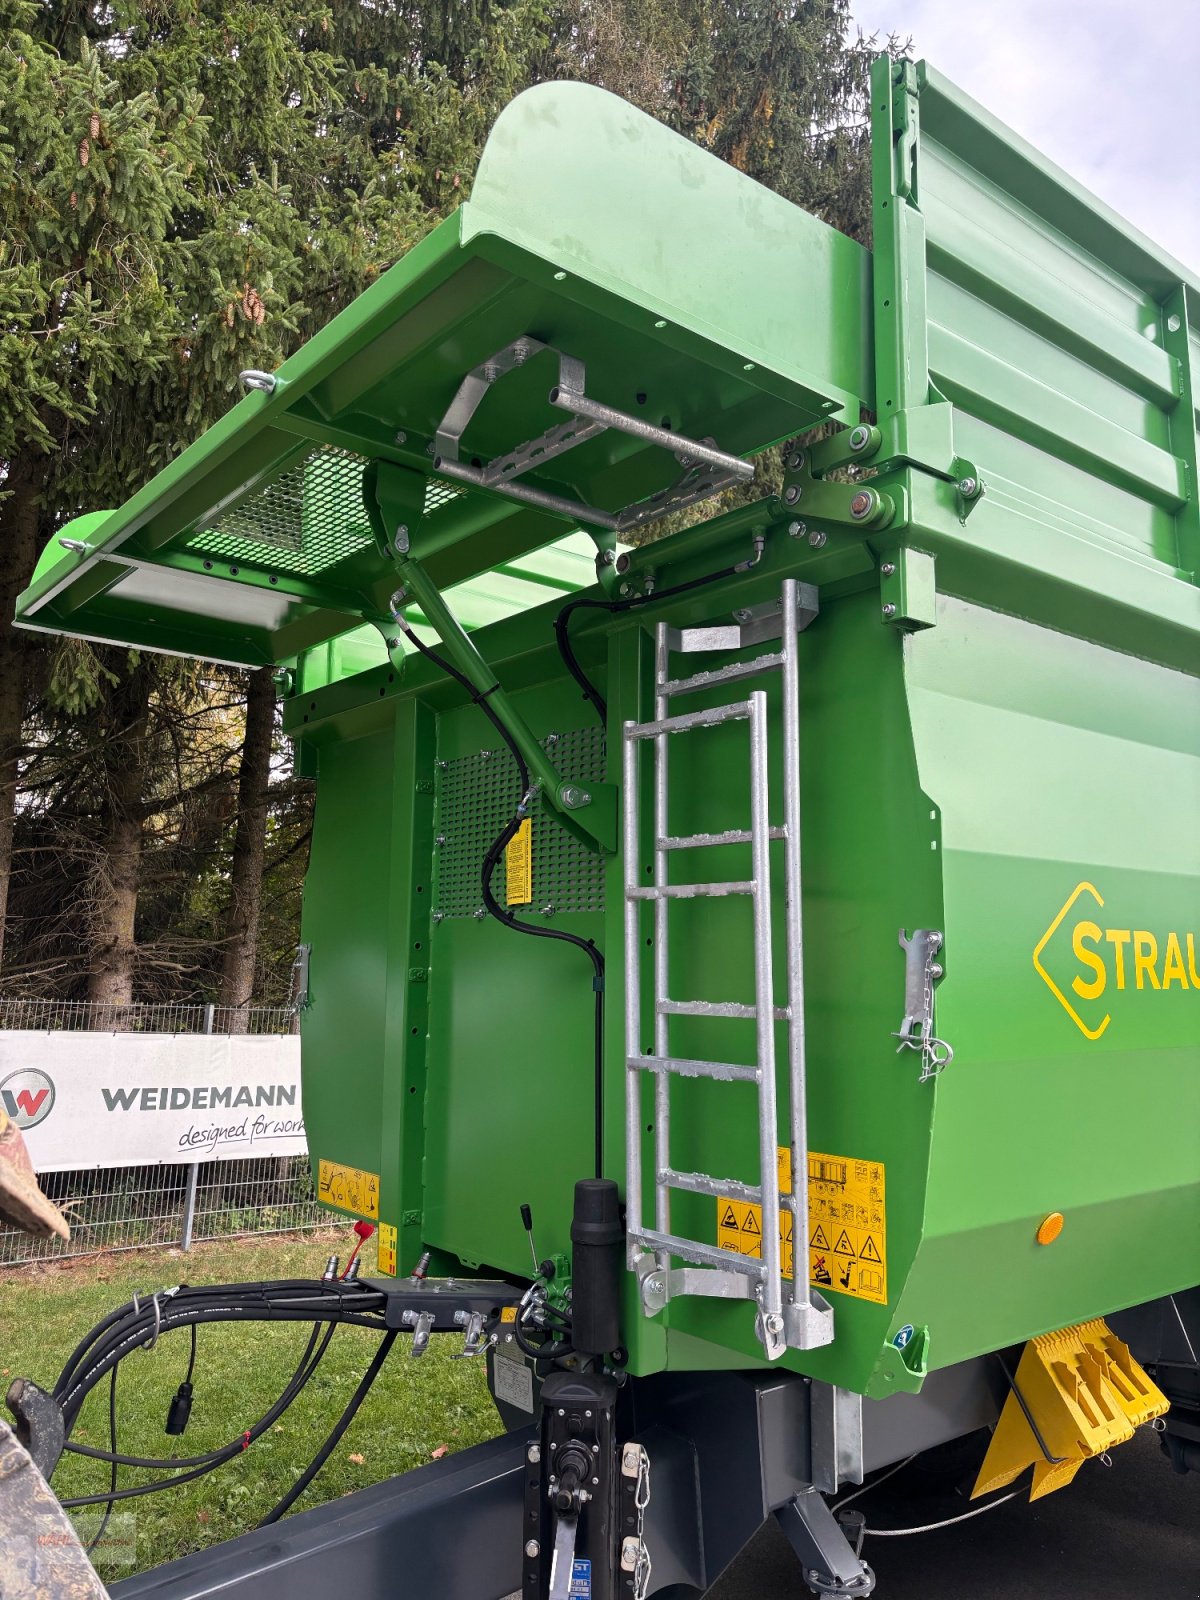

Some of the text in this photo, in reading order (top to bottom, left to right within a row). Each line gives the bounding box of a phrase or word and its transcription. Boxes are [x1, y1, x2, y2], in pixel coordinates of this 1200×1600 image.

[101, 1084, 296, 1112] WEIDEMANN
[178, 1116, 249, 1153] designed
[250, 1114, 274, 1144] for
